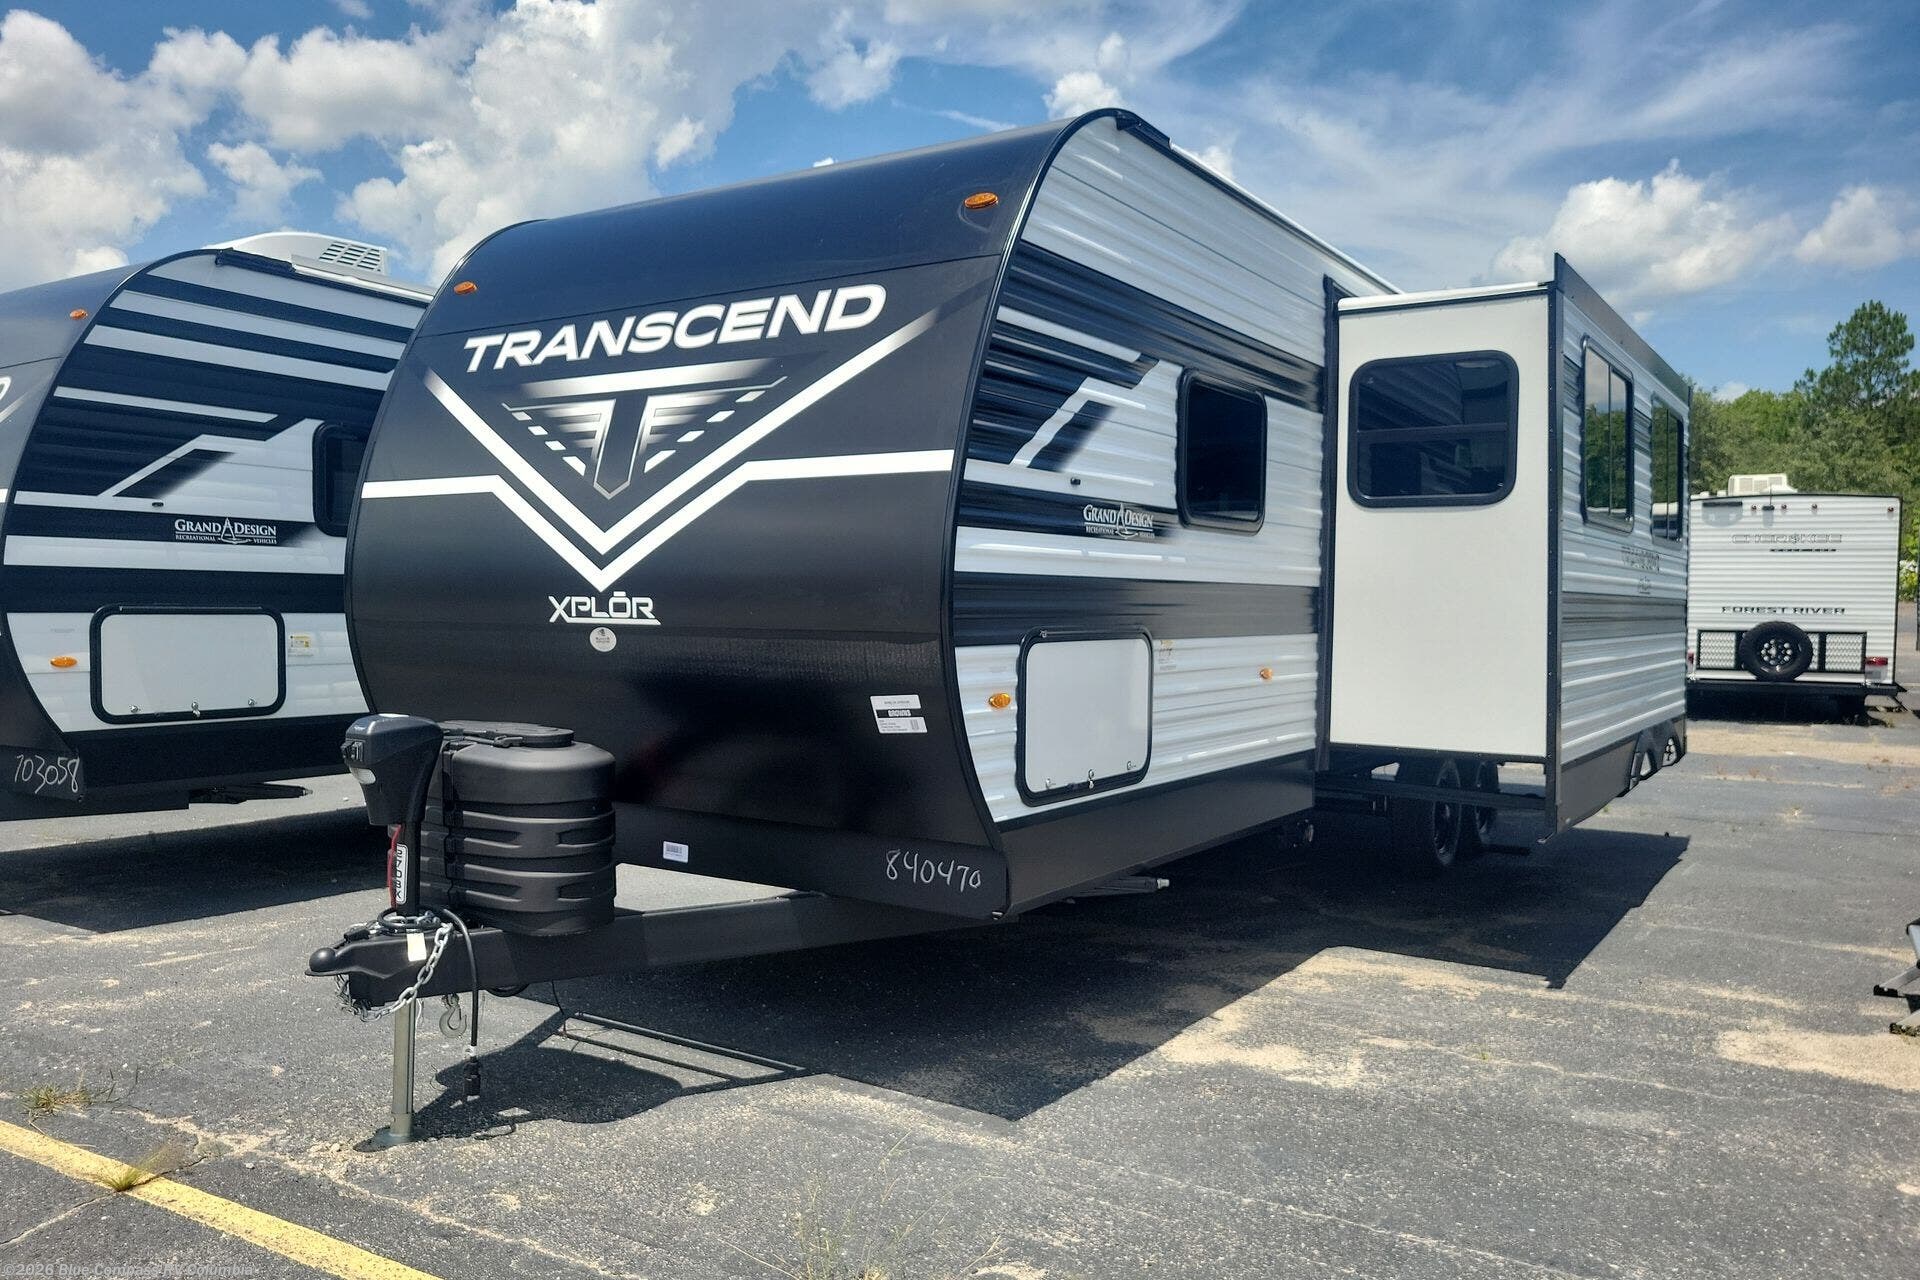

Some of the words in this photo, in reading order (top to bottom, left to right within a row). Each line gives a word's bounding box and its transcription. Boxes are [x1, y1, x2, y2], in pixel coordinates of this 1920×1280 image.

[463, 283, 887, 373] TRANSCEND
[174, 519, 221, 533] GRAND
[234, 521, 277, 536] DESIGN
[1083, 504, 1116, 523] GRAND
[1125, 509, 1154, 528] DESIGN
[1721, 606, 1788, 614] FOREST
[1793, 606, 1845, 615] RIVER
[886, 849, 981, 893] 840470
